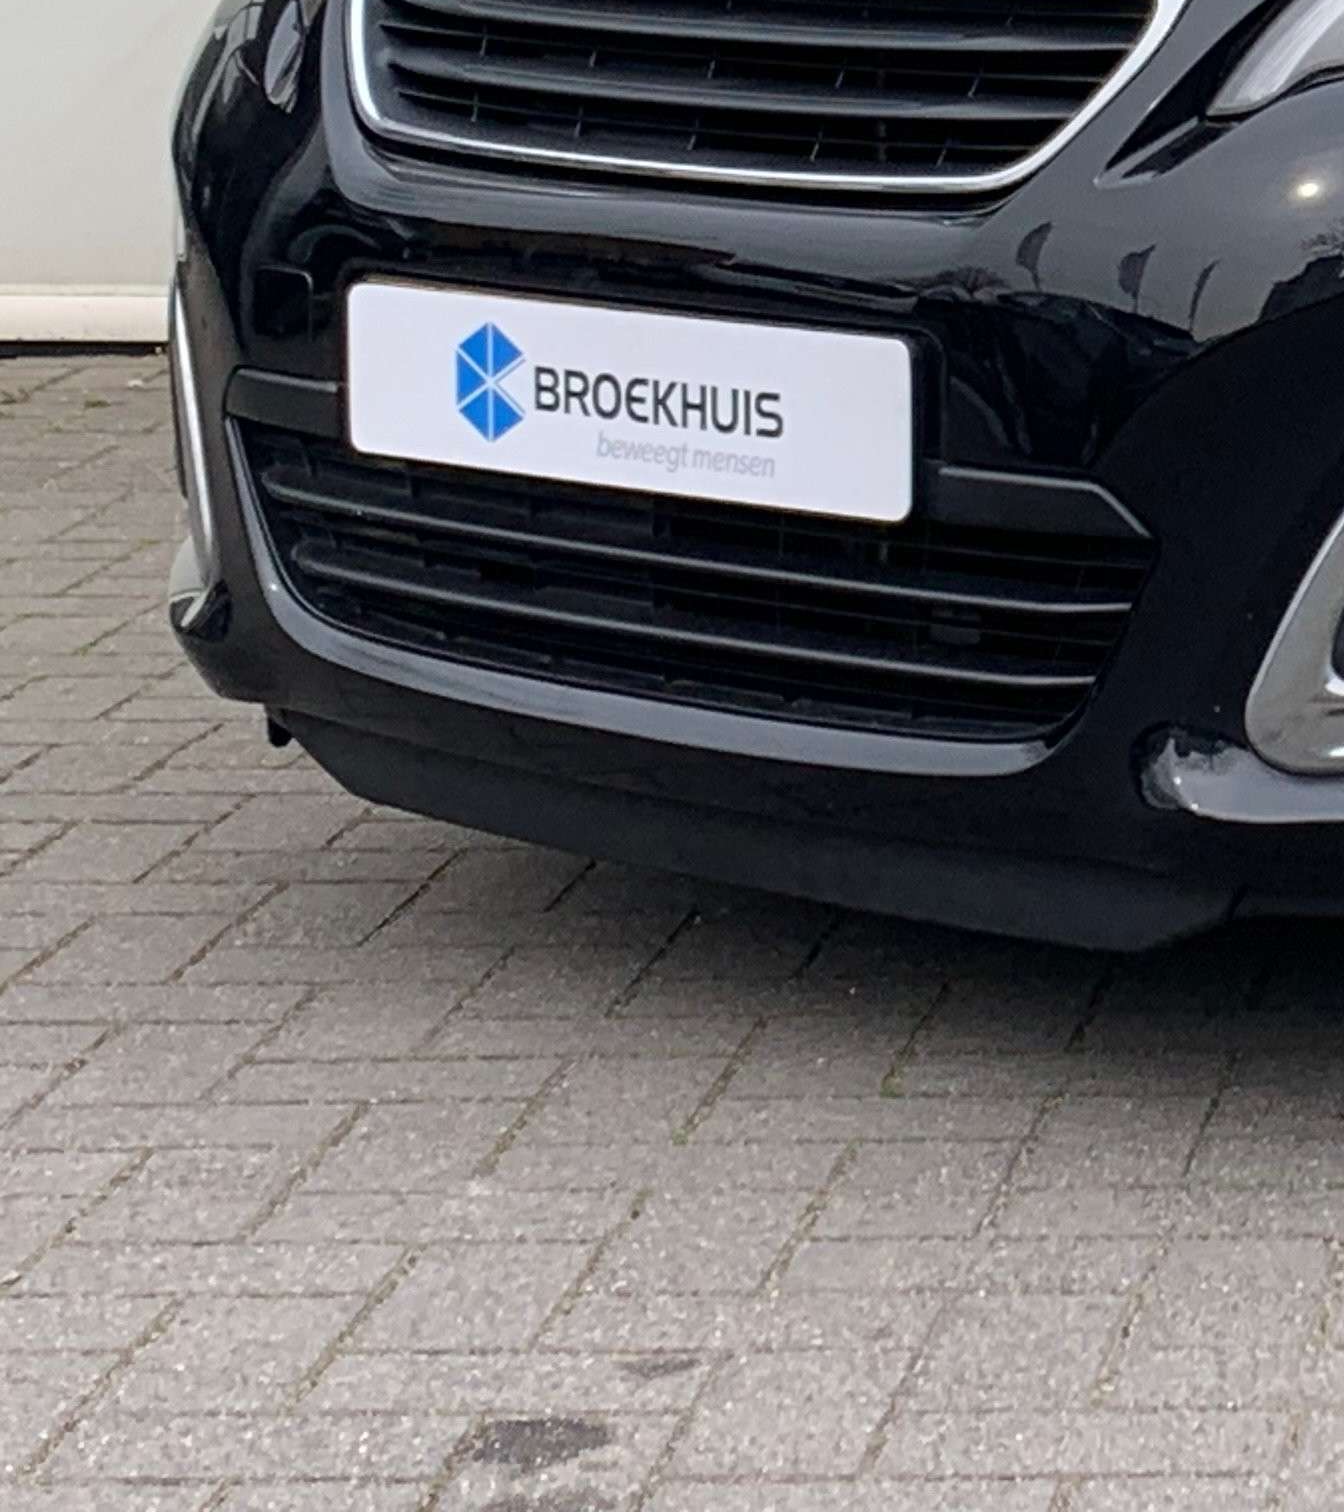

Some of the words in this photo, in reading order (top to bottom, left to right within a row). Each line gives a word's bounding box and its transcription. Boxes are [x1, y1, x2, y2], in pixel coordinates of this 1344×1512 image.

[534, 366, 784, 439] BROEKHUIS
[596, 431, 689, 473] beweegt
[692, 450, 775, 478] mensen
